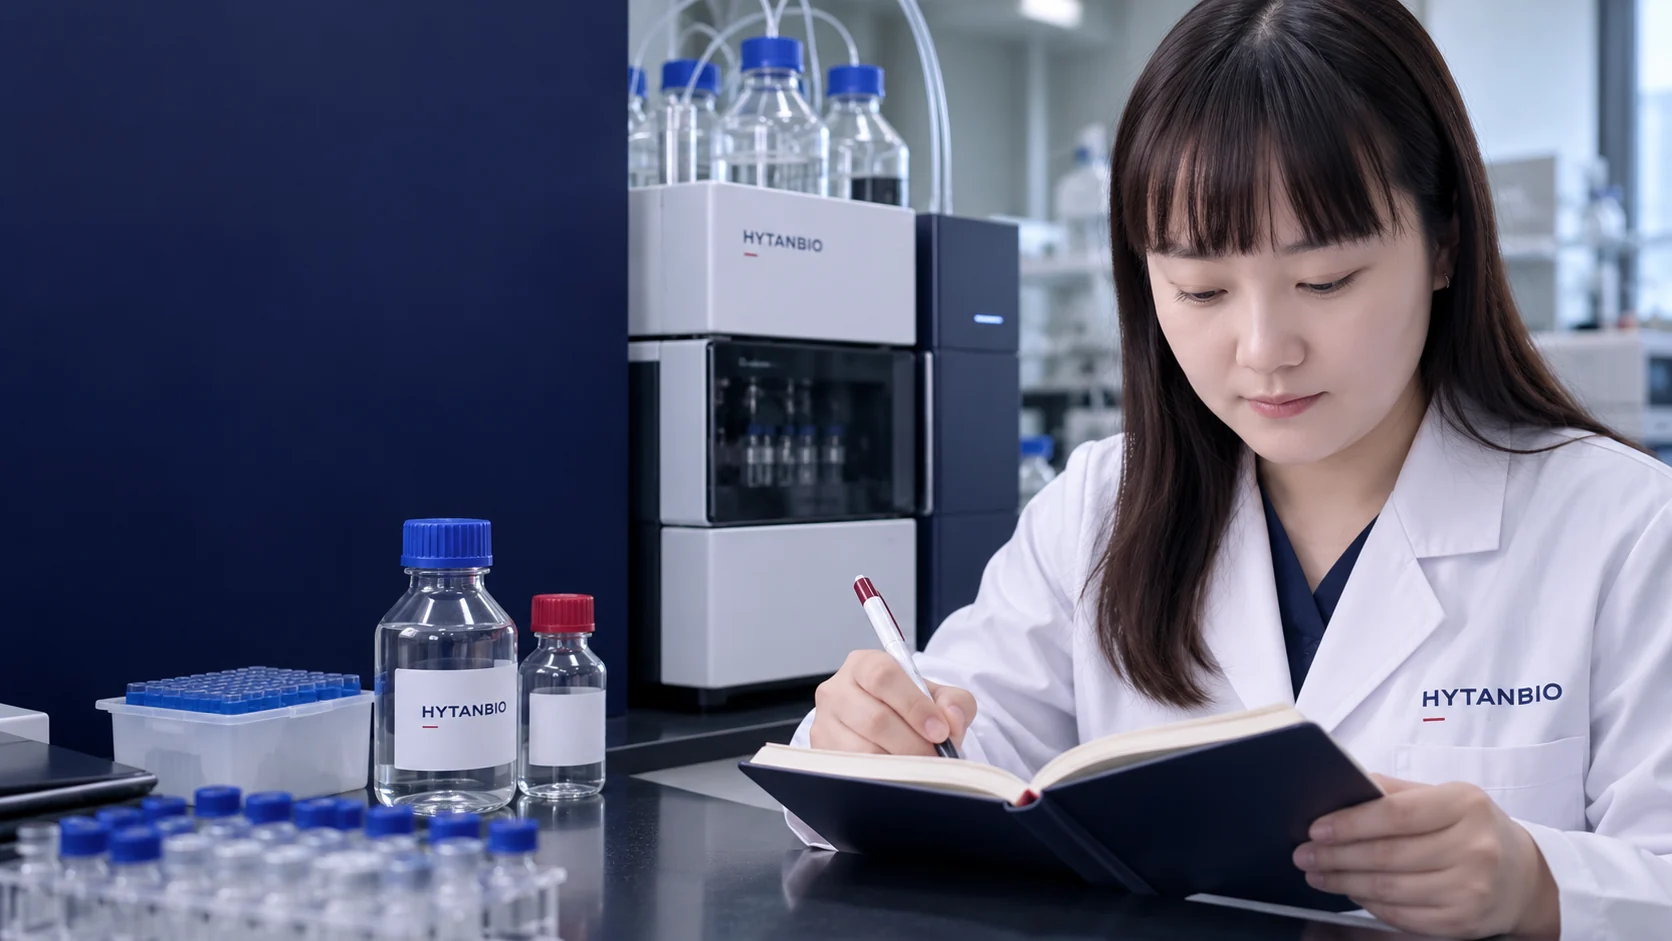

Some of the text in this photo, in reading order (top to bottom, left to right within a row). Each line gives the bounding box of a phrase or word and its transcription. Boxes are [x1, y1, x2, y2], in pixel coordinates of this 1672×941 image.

[743, 229, 823, 252] HYTANBIO
[1422, 682, 1562, 707] HYTANBIO
[422, 701, 506, 718] HYTANBIO
